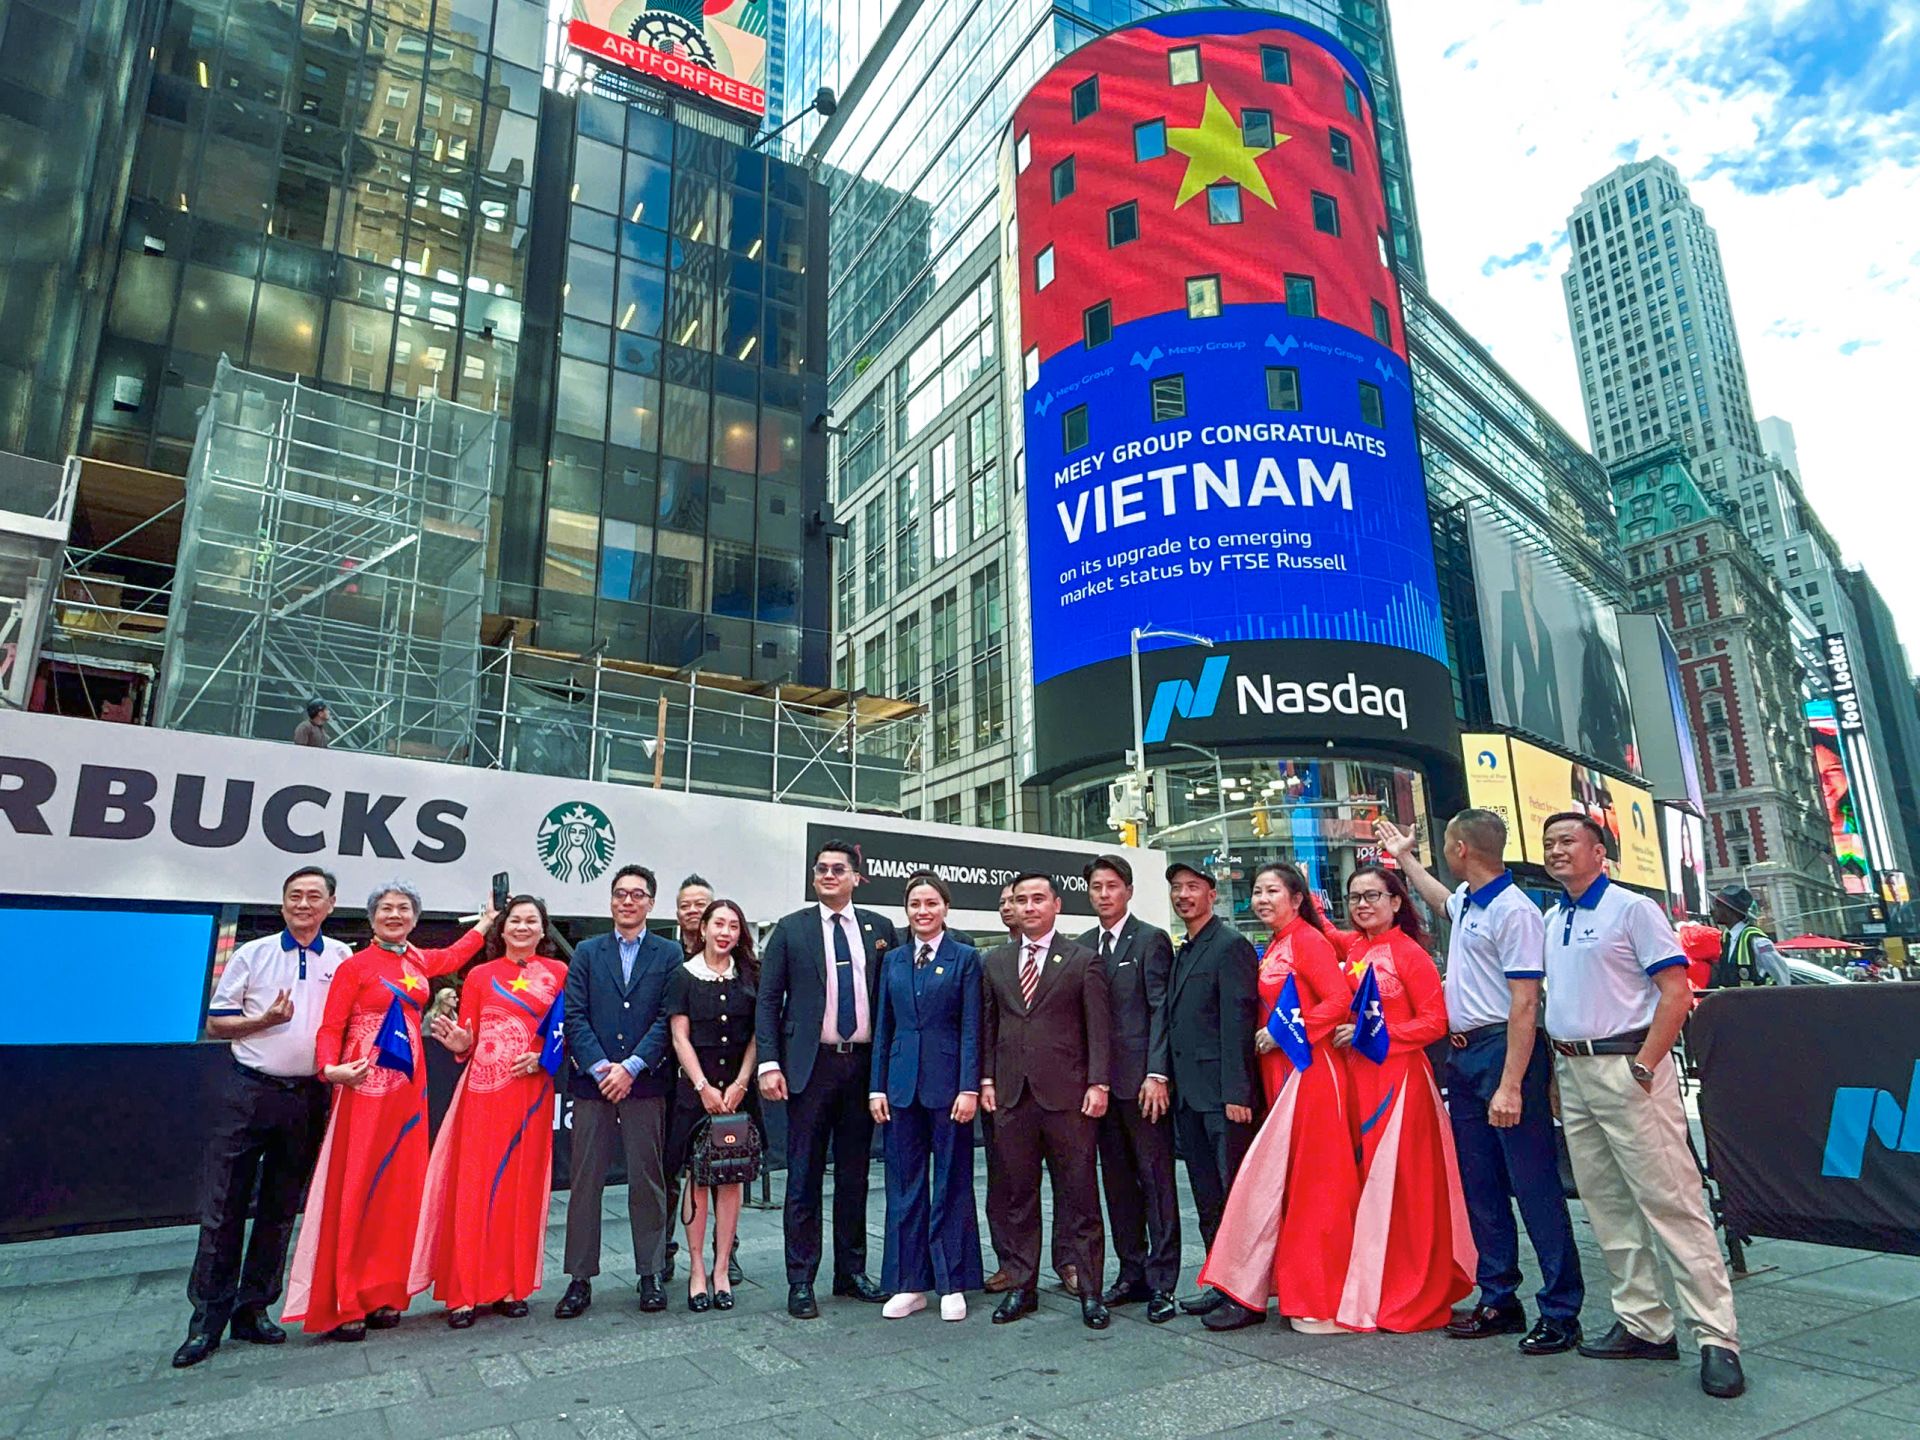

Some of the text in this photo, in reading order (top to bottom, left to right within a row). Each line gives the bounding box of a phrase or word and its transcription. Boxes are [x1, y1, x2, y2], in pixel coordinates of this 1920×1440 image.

[1081, 366, 1114, 384] Group
[1168, 341, 1246, 356] Meey Group
[1303, 341, 1365, 363] Meey Group
[1054, 423, 1387, 489] MEEY GROUP CONGRATULATES
[1056, 457, 1353, 544] VIETNAM
[1060, 528, 1312, 584] on its upgrade to emerging
[1060, 552, 1347, 607] market status by FTSE Russell
[1236, 672, 1408, 730] Nasdaq
[1827, 638, 1862, 730] Foot Locker
[1060, 875, 1088, 892] YOR
